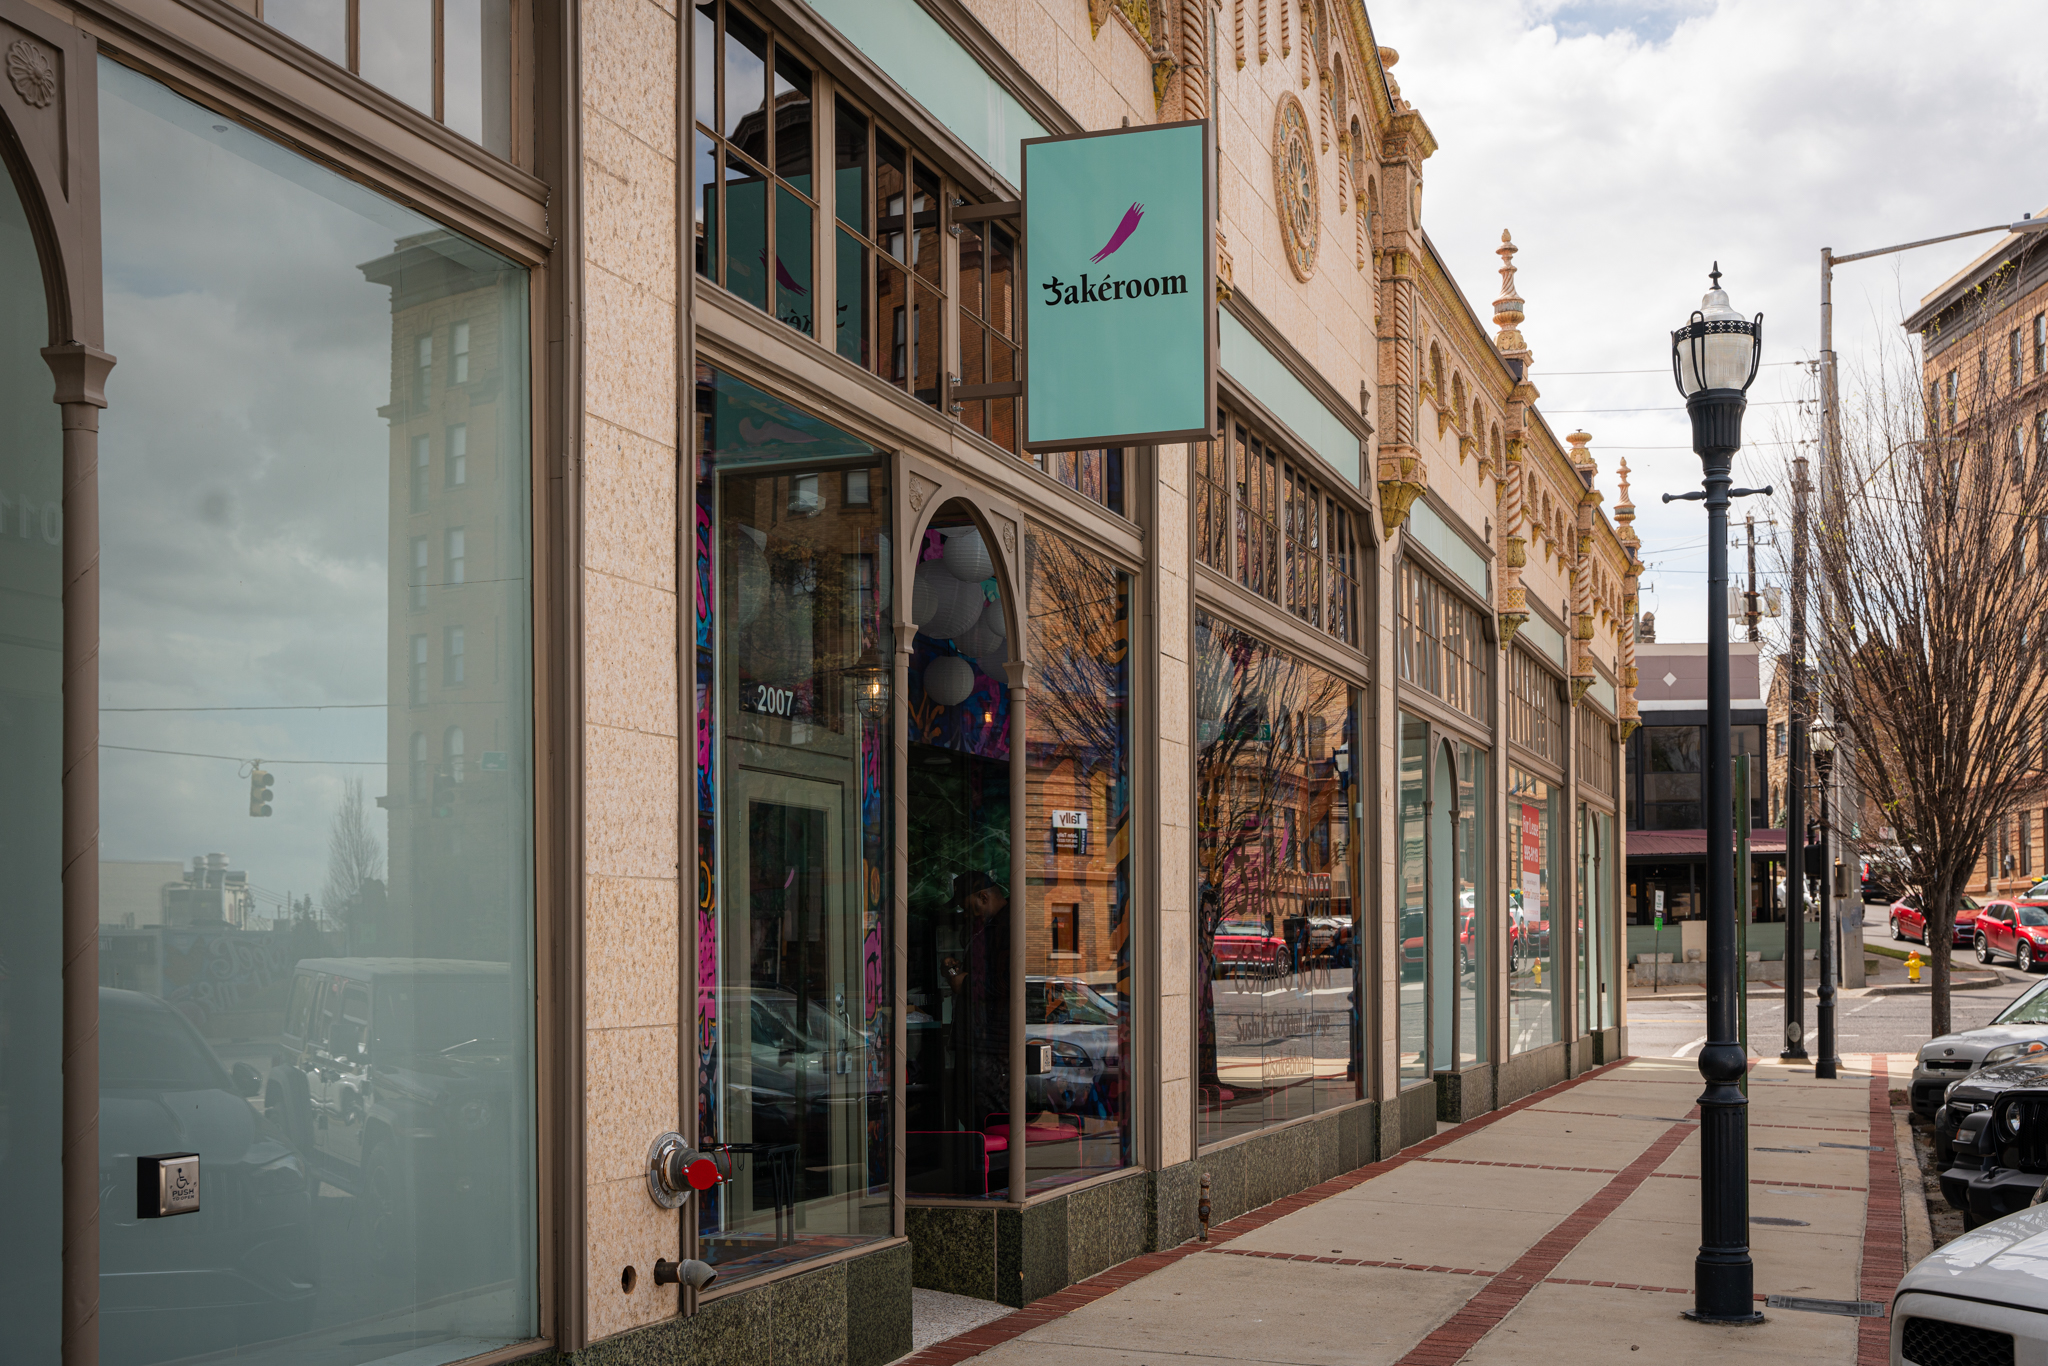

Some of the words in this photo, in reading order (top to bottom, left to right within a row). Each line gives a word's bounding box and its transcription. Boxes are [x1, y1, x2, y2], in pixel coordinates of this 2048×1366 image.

[757, 684, 794, 717] 2007
[1235, 953, 1293, 994] COMING
[1297, 953, 1331, 993] SOON
[1236, 1011, 1260, 1042] Sushi
[1263, 1012, 1269, 1039] &
[1271, 1007, 1303, 1038] Cocktail
[1304, 1008, 1331, 1037] Lounge
[172, 1188, 194, 1196] PUSH
